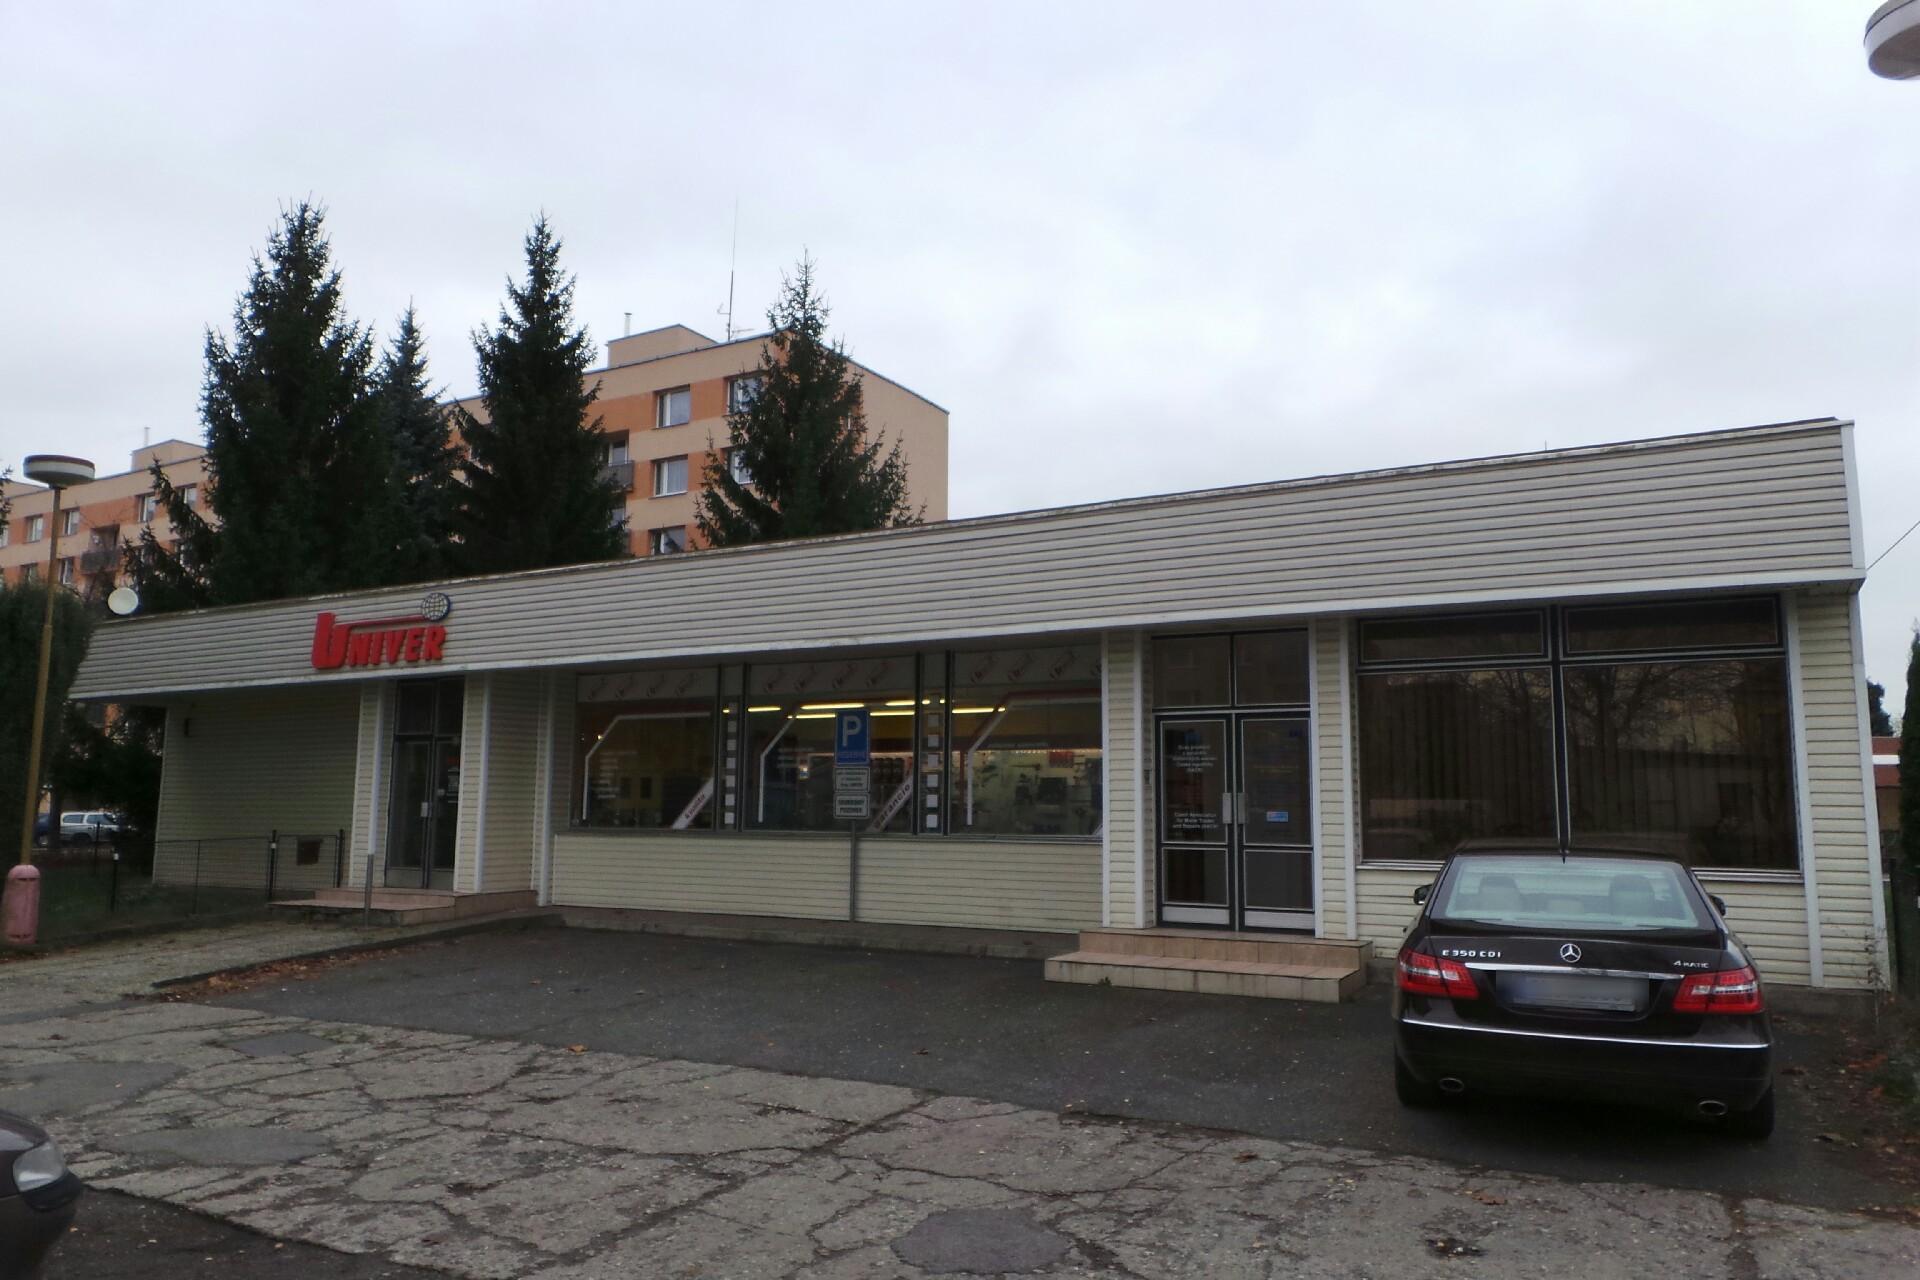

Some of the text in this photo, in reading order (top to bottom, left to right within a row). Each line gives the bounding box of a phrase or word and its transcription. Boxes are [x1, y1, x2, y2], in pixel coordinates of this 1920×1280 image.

[311, 612, 447, 669] UNIVER
[842, 715, 861, 747] P
[1452, 949, 1476, 957] 350
[1479, 950, 1501, 958] CDI
